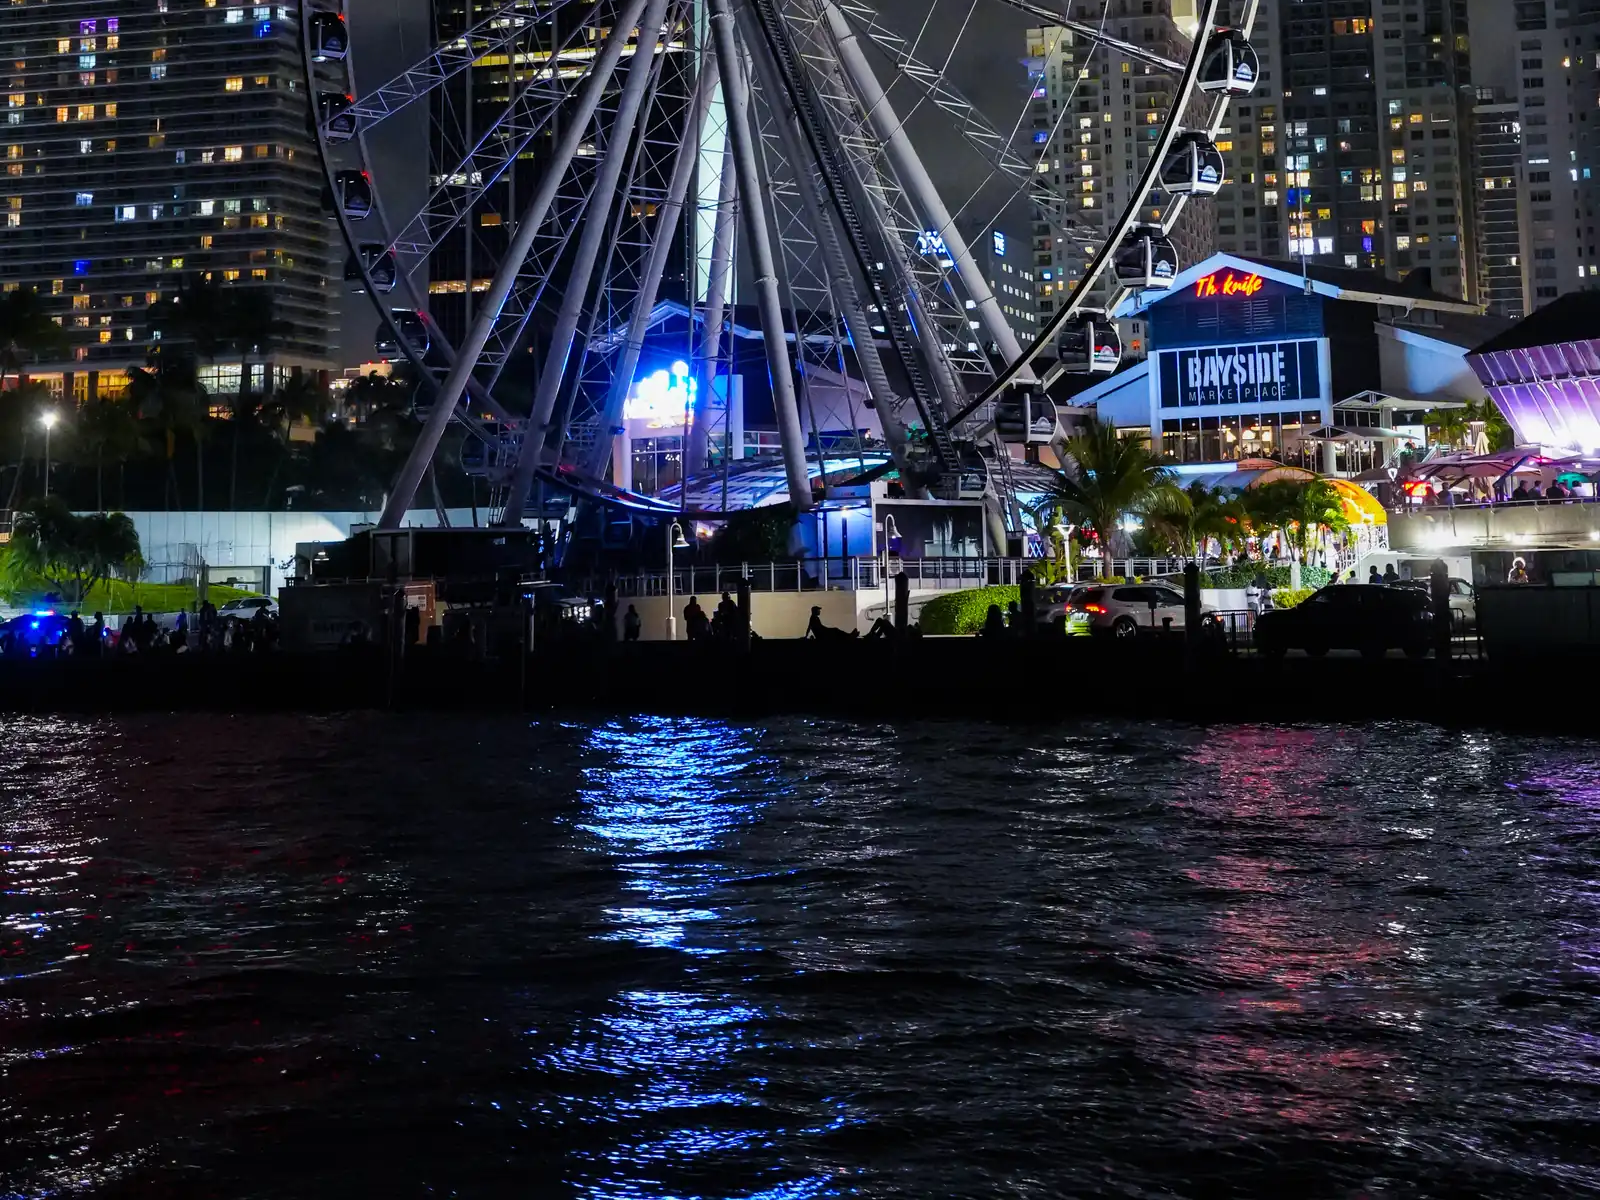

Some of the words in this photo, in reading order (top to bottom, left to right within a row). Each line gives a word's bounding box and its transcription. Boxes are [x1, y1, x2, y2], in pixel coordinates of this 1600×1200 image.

[1223, 272, 1263, 297] knife
[1187, 351, 1286, 388] BAYSIDE
[1188, 385, 1287, 401] MARKEPLACE
